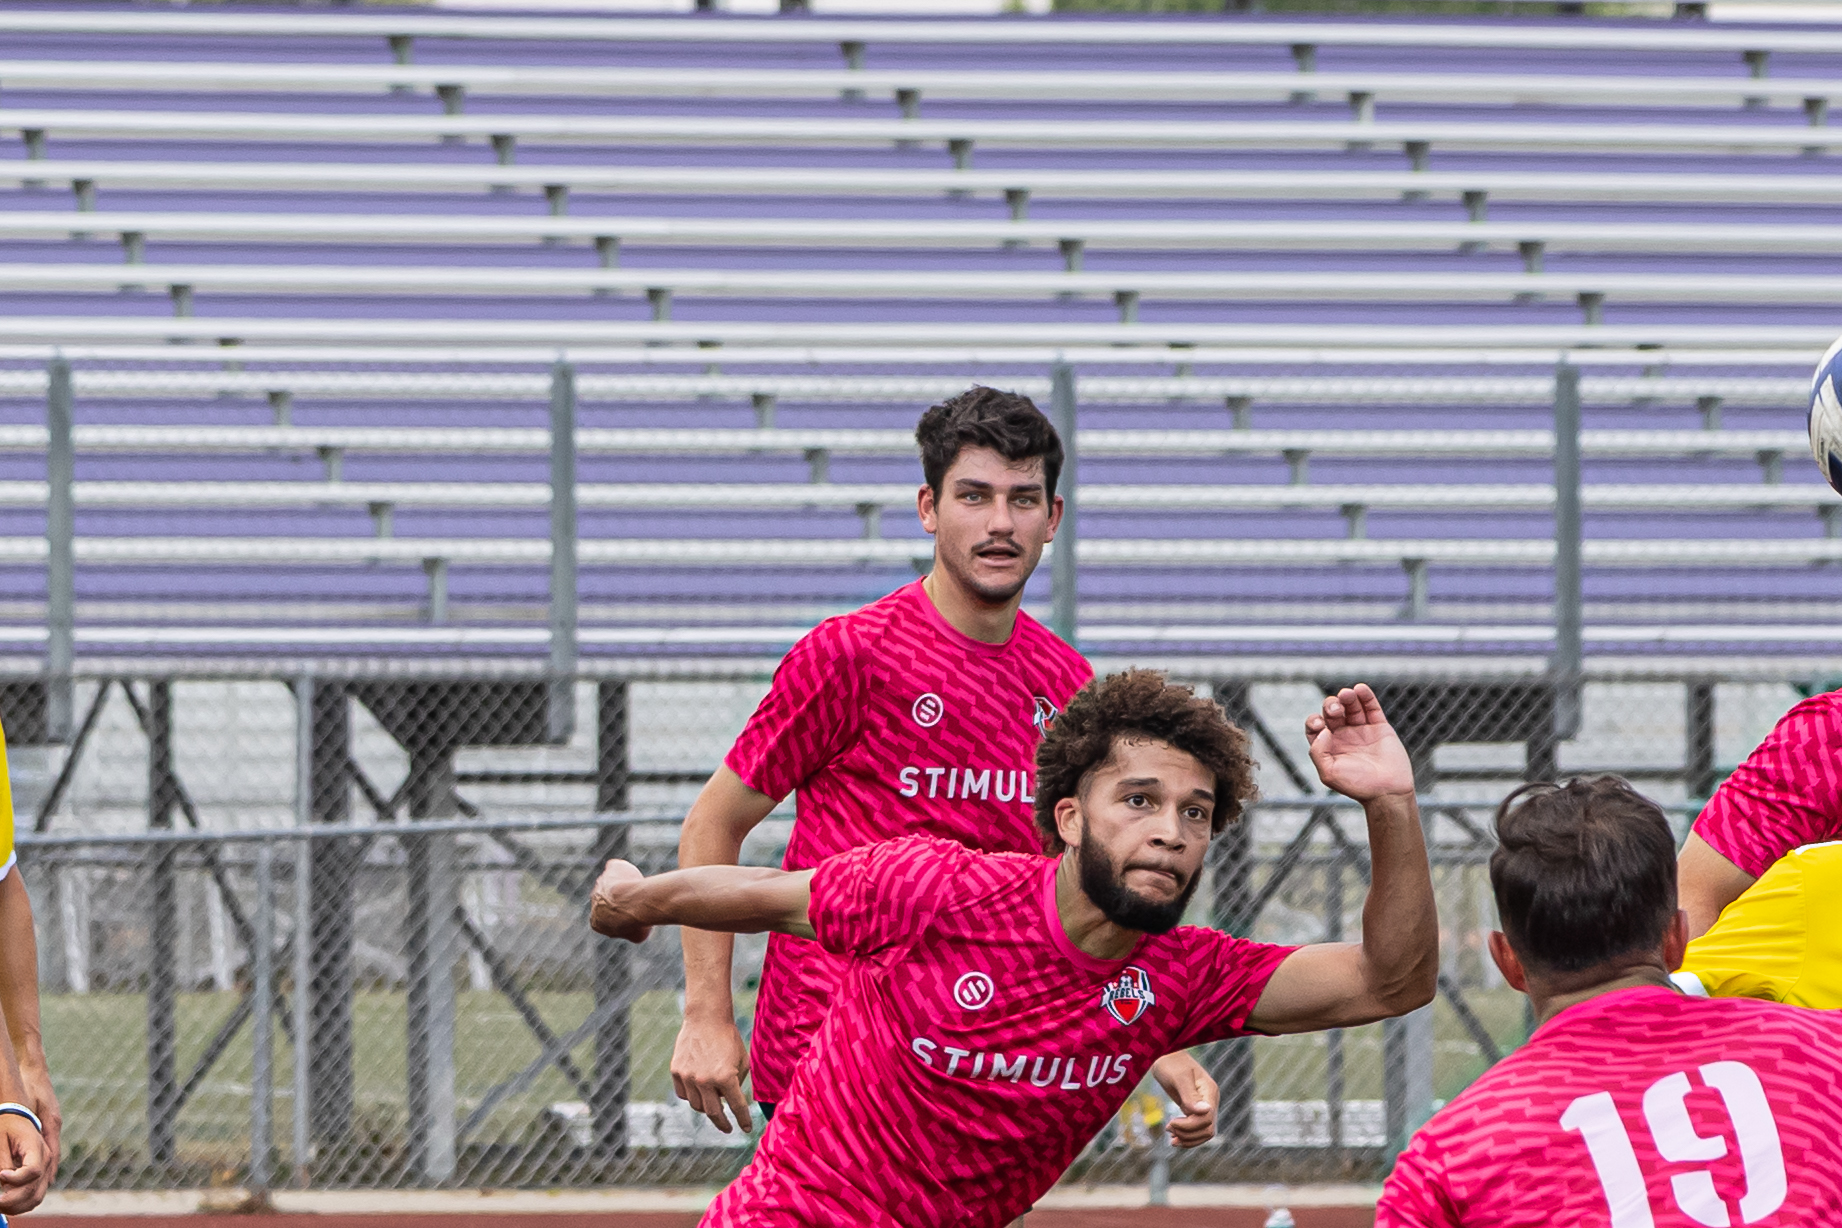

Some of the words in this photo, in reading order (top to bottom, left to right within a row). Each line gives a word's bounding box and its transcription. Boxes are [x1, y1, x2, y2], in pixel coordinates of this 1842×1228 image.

[899, 766, 1036, 803] STIMUL
[1108, 987, 1146, 1001] REBELS
[912, 1037, 1132, 1090] STIMULUS
